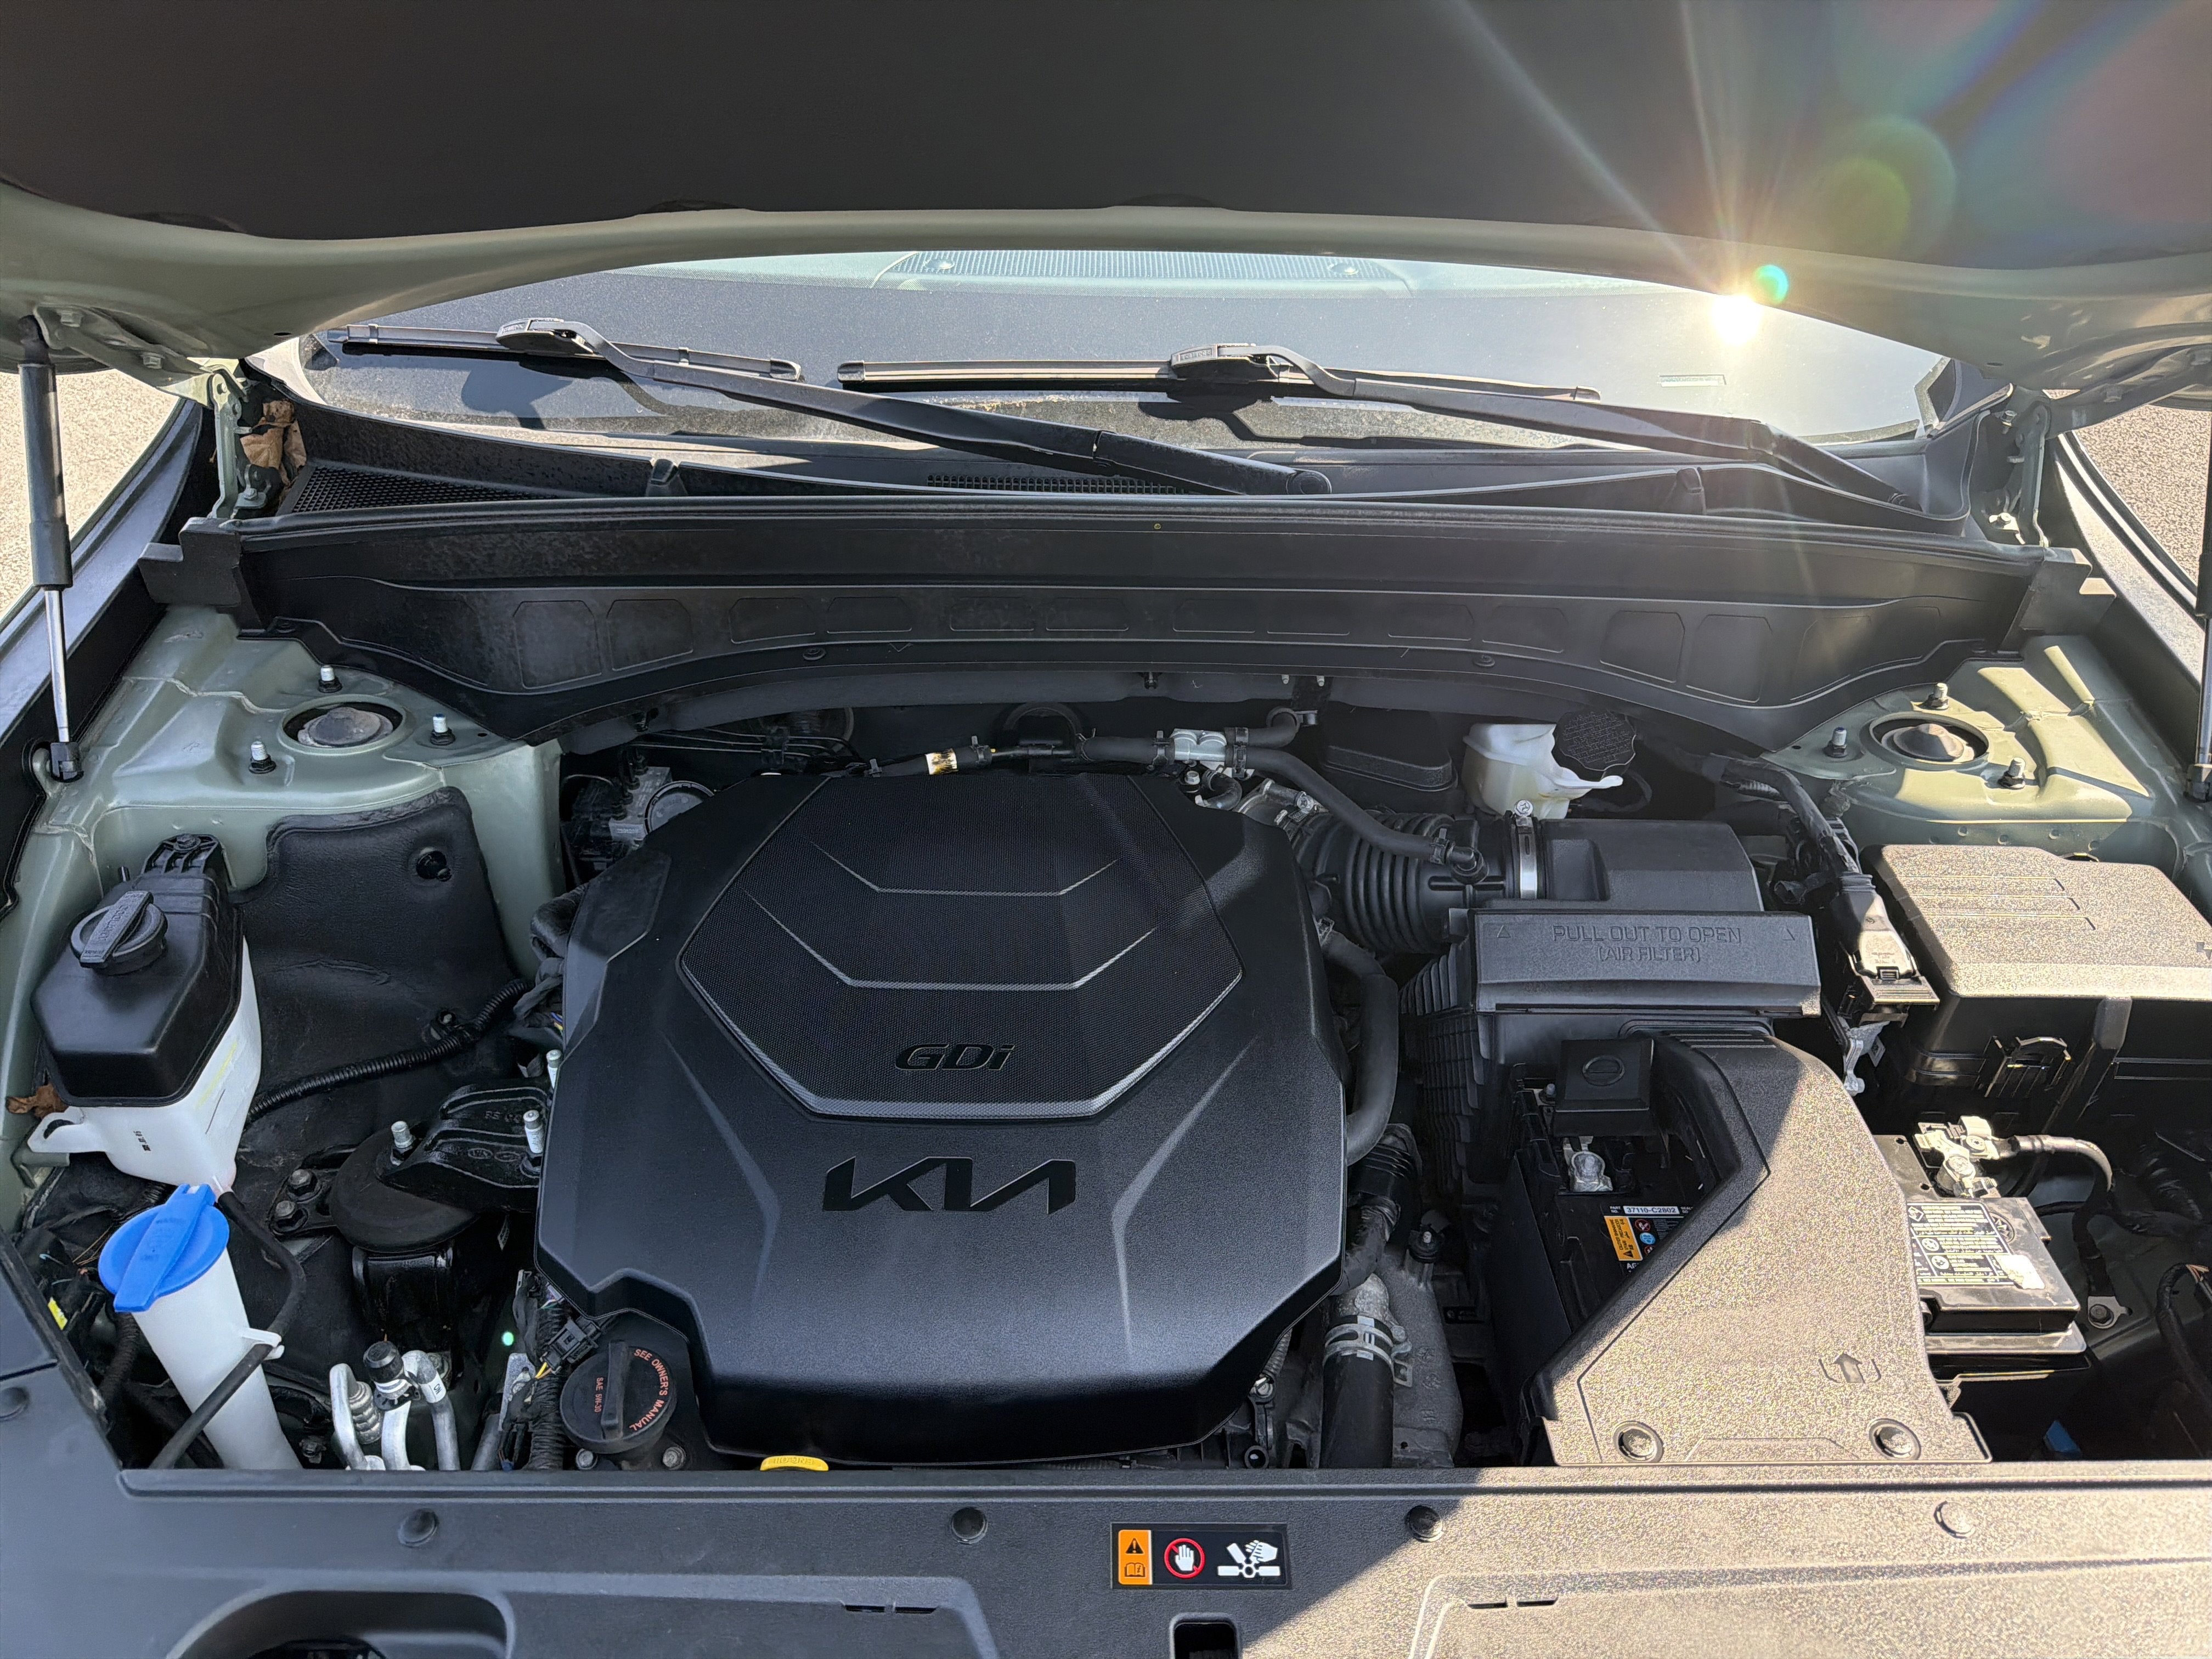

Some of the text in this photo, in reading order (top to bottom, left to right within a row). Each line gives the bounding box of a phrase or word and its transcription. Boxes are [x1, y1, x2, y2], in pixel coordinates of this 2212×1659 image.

[1552, 925, 1741, 943] PULL OUT TO OPEN
[1599, 946, 1701, 963] (AIR FILTER)
[895, 1043, 1015, 1071] GDi
[823, 1156, 1076, 1215] KIA
[594, 1377, 604, 1413] SAE 5W-30
[629, 1348, 669, 1430] SEE OWNER'S MANUAL
